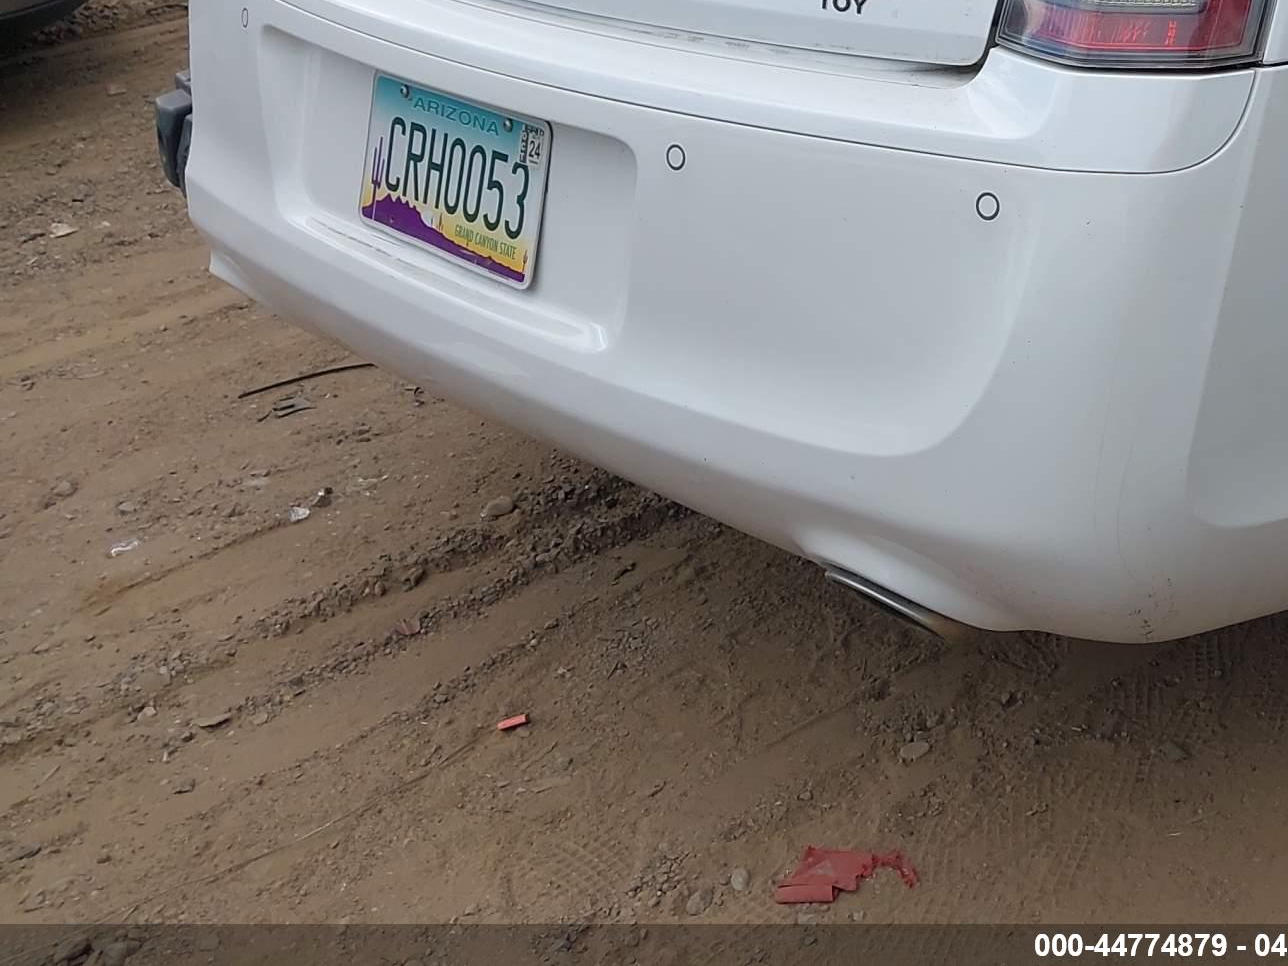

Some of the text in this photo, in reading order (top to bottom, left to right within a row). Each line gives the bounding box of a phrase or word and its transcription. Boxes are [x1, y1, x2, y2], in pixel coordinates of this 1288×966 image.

[412, 96, 500, 136] ARIZONA
[528, 139, 541, 161] 24
[384, 116, 530, 240] CRH0053
[454, 224, 518, 260] GRAND CANYON STATE
